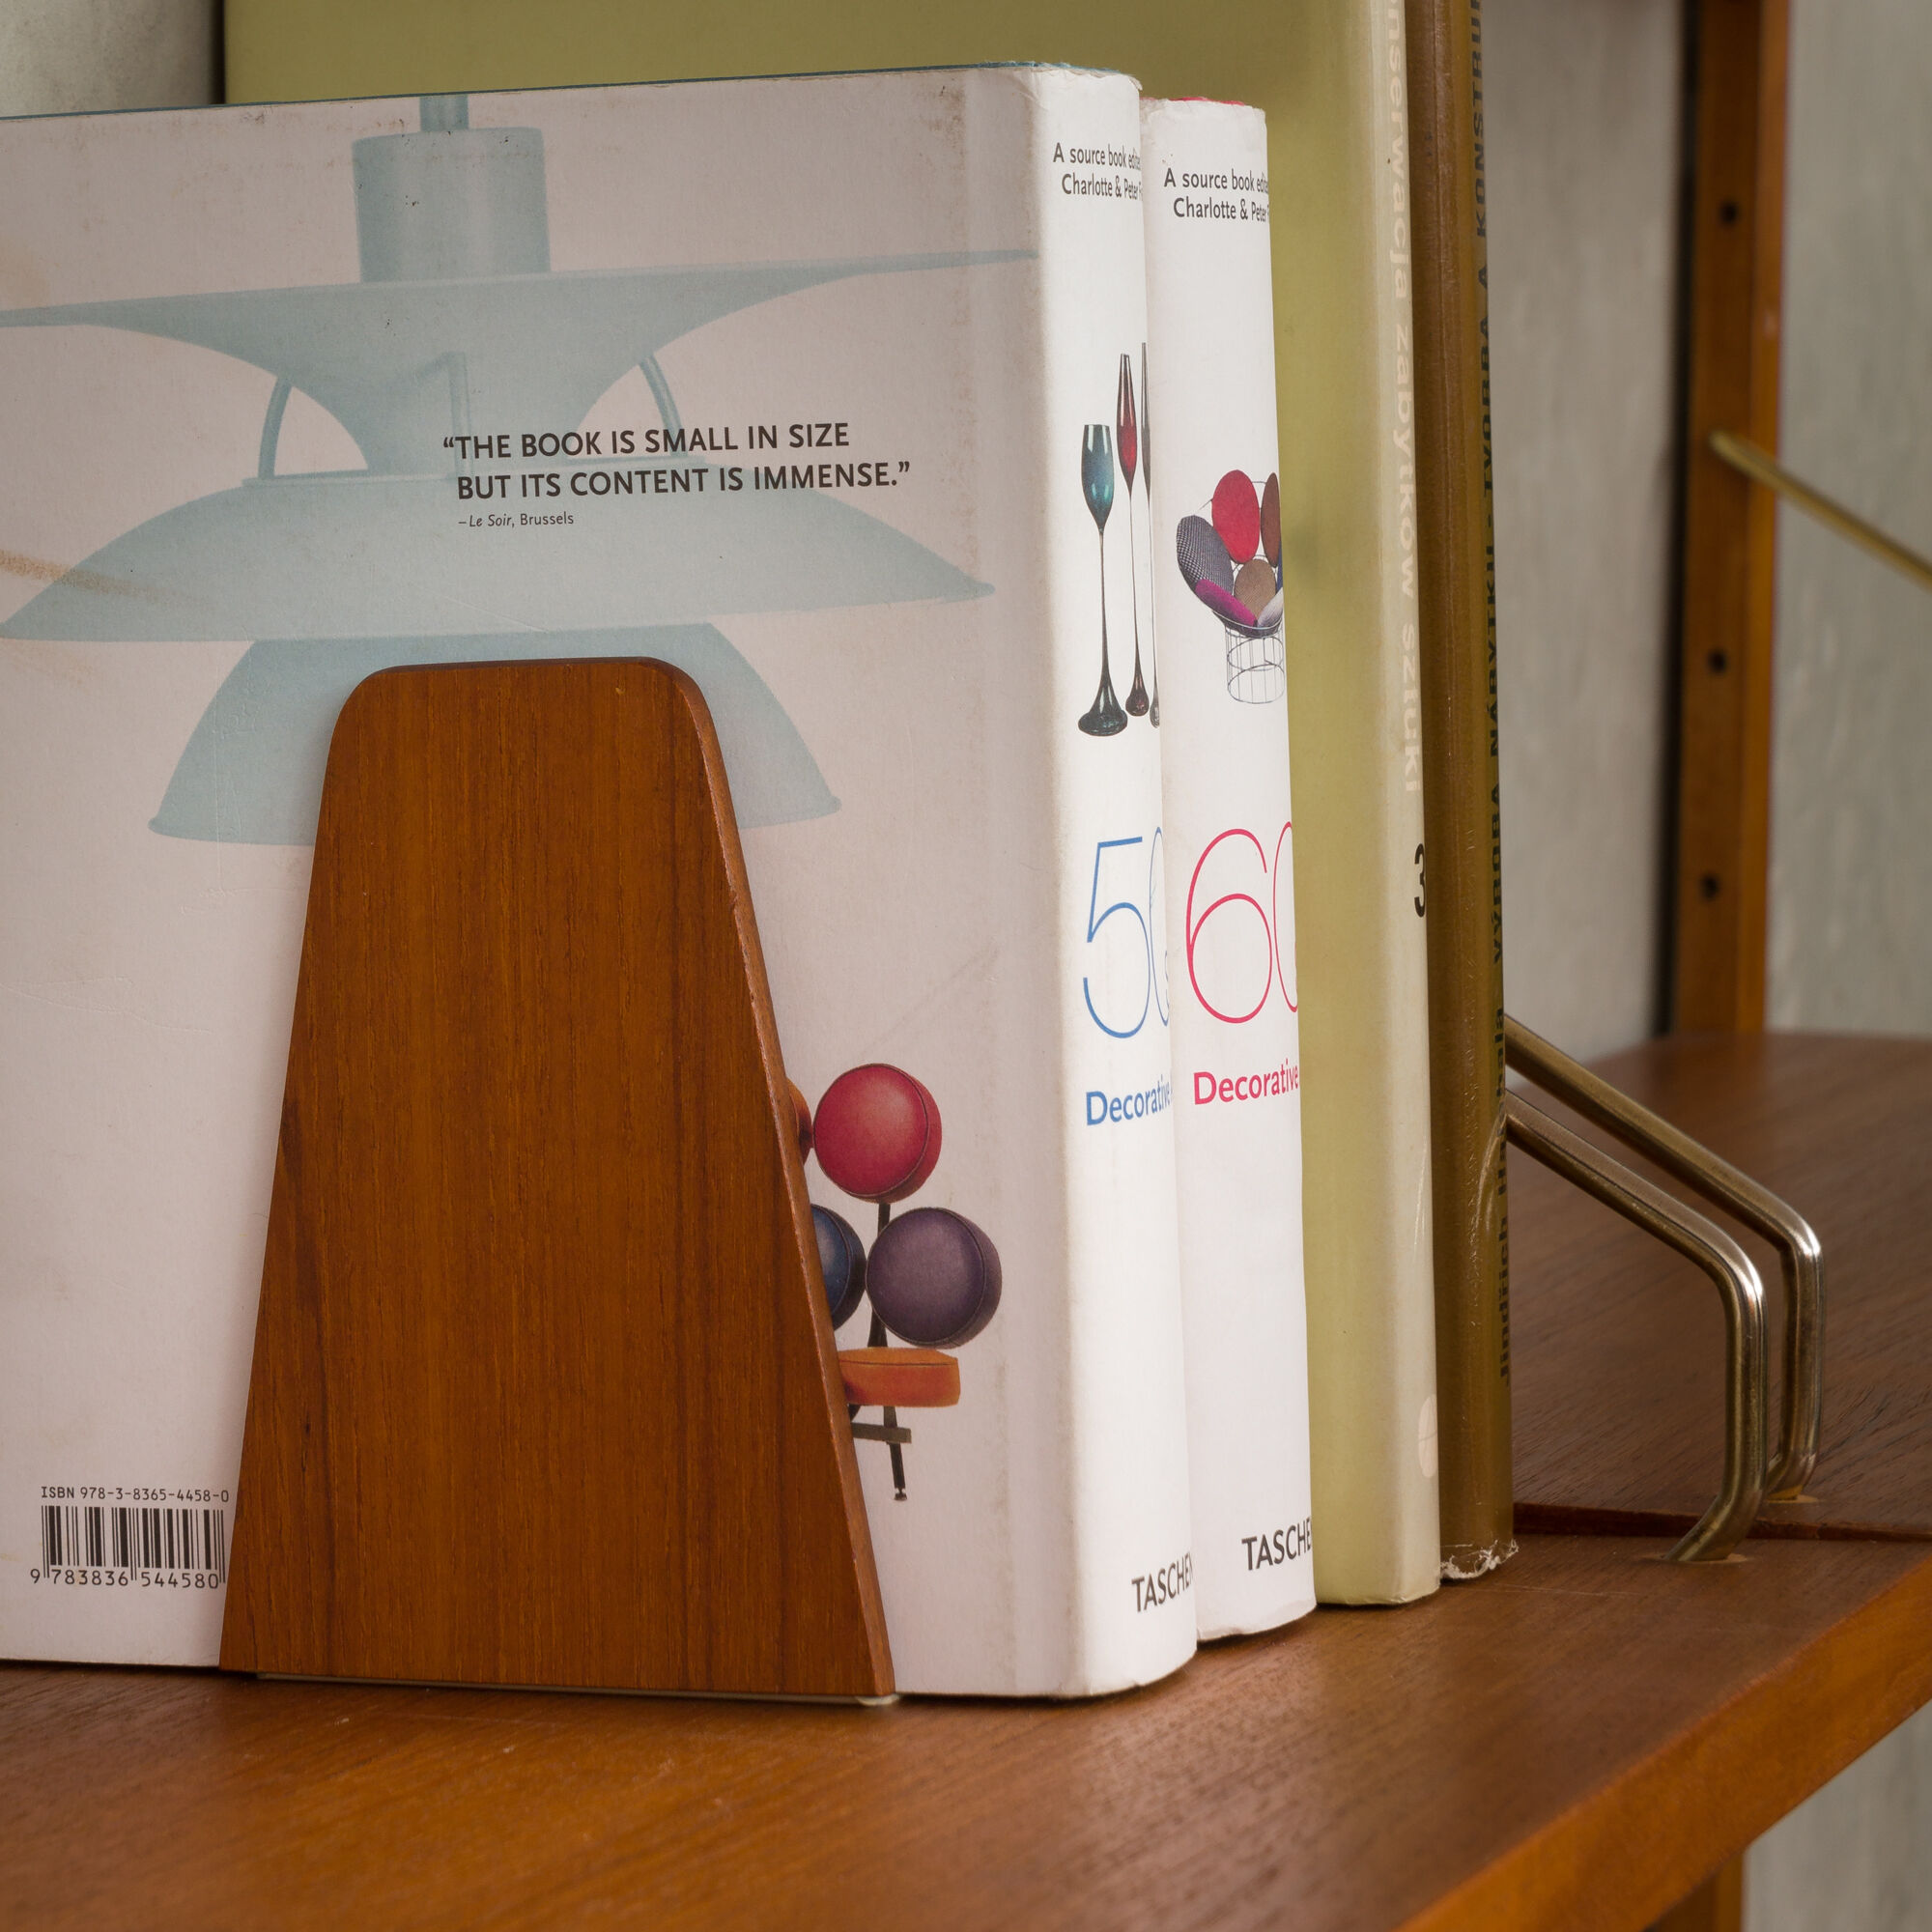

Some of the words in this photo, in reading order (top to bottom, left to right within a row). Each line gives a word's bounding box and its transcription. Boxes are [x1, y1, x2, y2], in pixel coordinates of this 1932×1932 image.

[1053, 142, 1065, 163] A
[1069, 147, 1105, 165] source
[1108, 144, 1126, 168] book
[1062, 172, 1113, 197] Charlotte
[1115, 175, 1122, 198] &
[1164, 167, 1176, 188] A
[1182, 171, 1228, 189] source
[1232, 168, 1255, 191] book
[1173, 196, 1236, 220] Charlotte
[1240, 198, 1248, 220] &
[522, 430, 602, 458] BOOK
[611, 429, 636, 455] IS
[645, 426, 738, 453] SMALL
[748, 424, 777, 450] IN
[788, 422, 850, 448] SIZE
[1388, 0, 1408, 298] nserwacja
[1402, 623, 1421, 792] sztuki
[1414, 842, 1426, 918] 3
[458, 475, 511, 499] BUT
[522, 472, 561, 497] ITS
[570, 469, 709, 497] CONTENT
[720, 467, 743, 492] IS
[487, 513, 515, 528] Soir,
[520, 511, 574, 526] Brussels
[1193, 1058, 1298, 1104] Decorative
[42, 1486, 74, 1498] ISBN
[80, 1487, 229, 1503] 978-3-8365-4458-0
[1241, 1517, 1312, 1571] TASCHE
[51, 1569, 128, 1586] 783836
[141, 1571, 219, 1589] 544580
